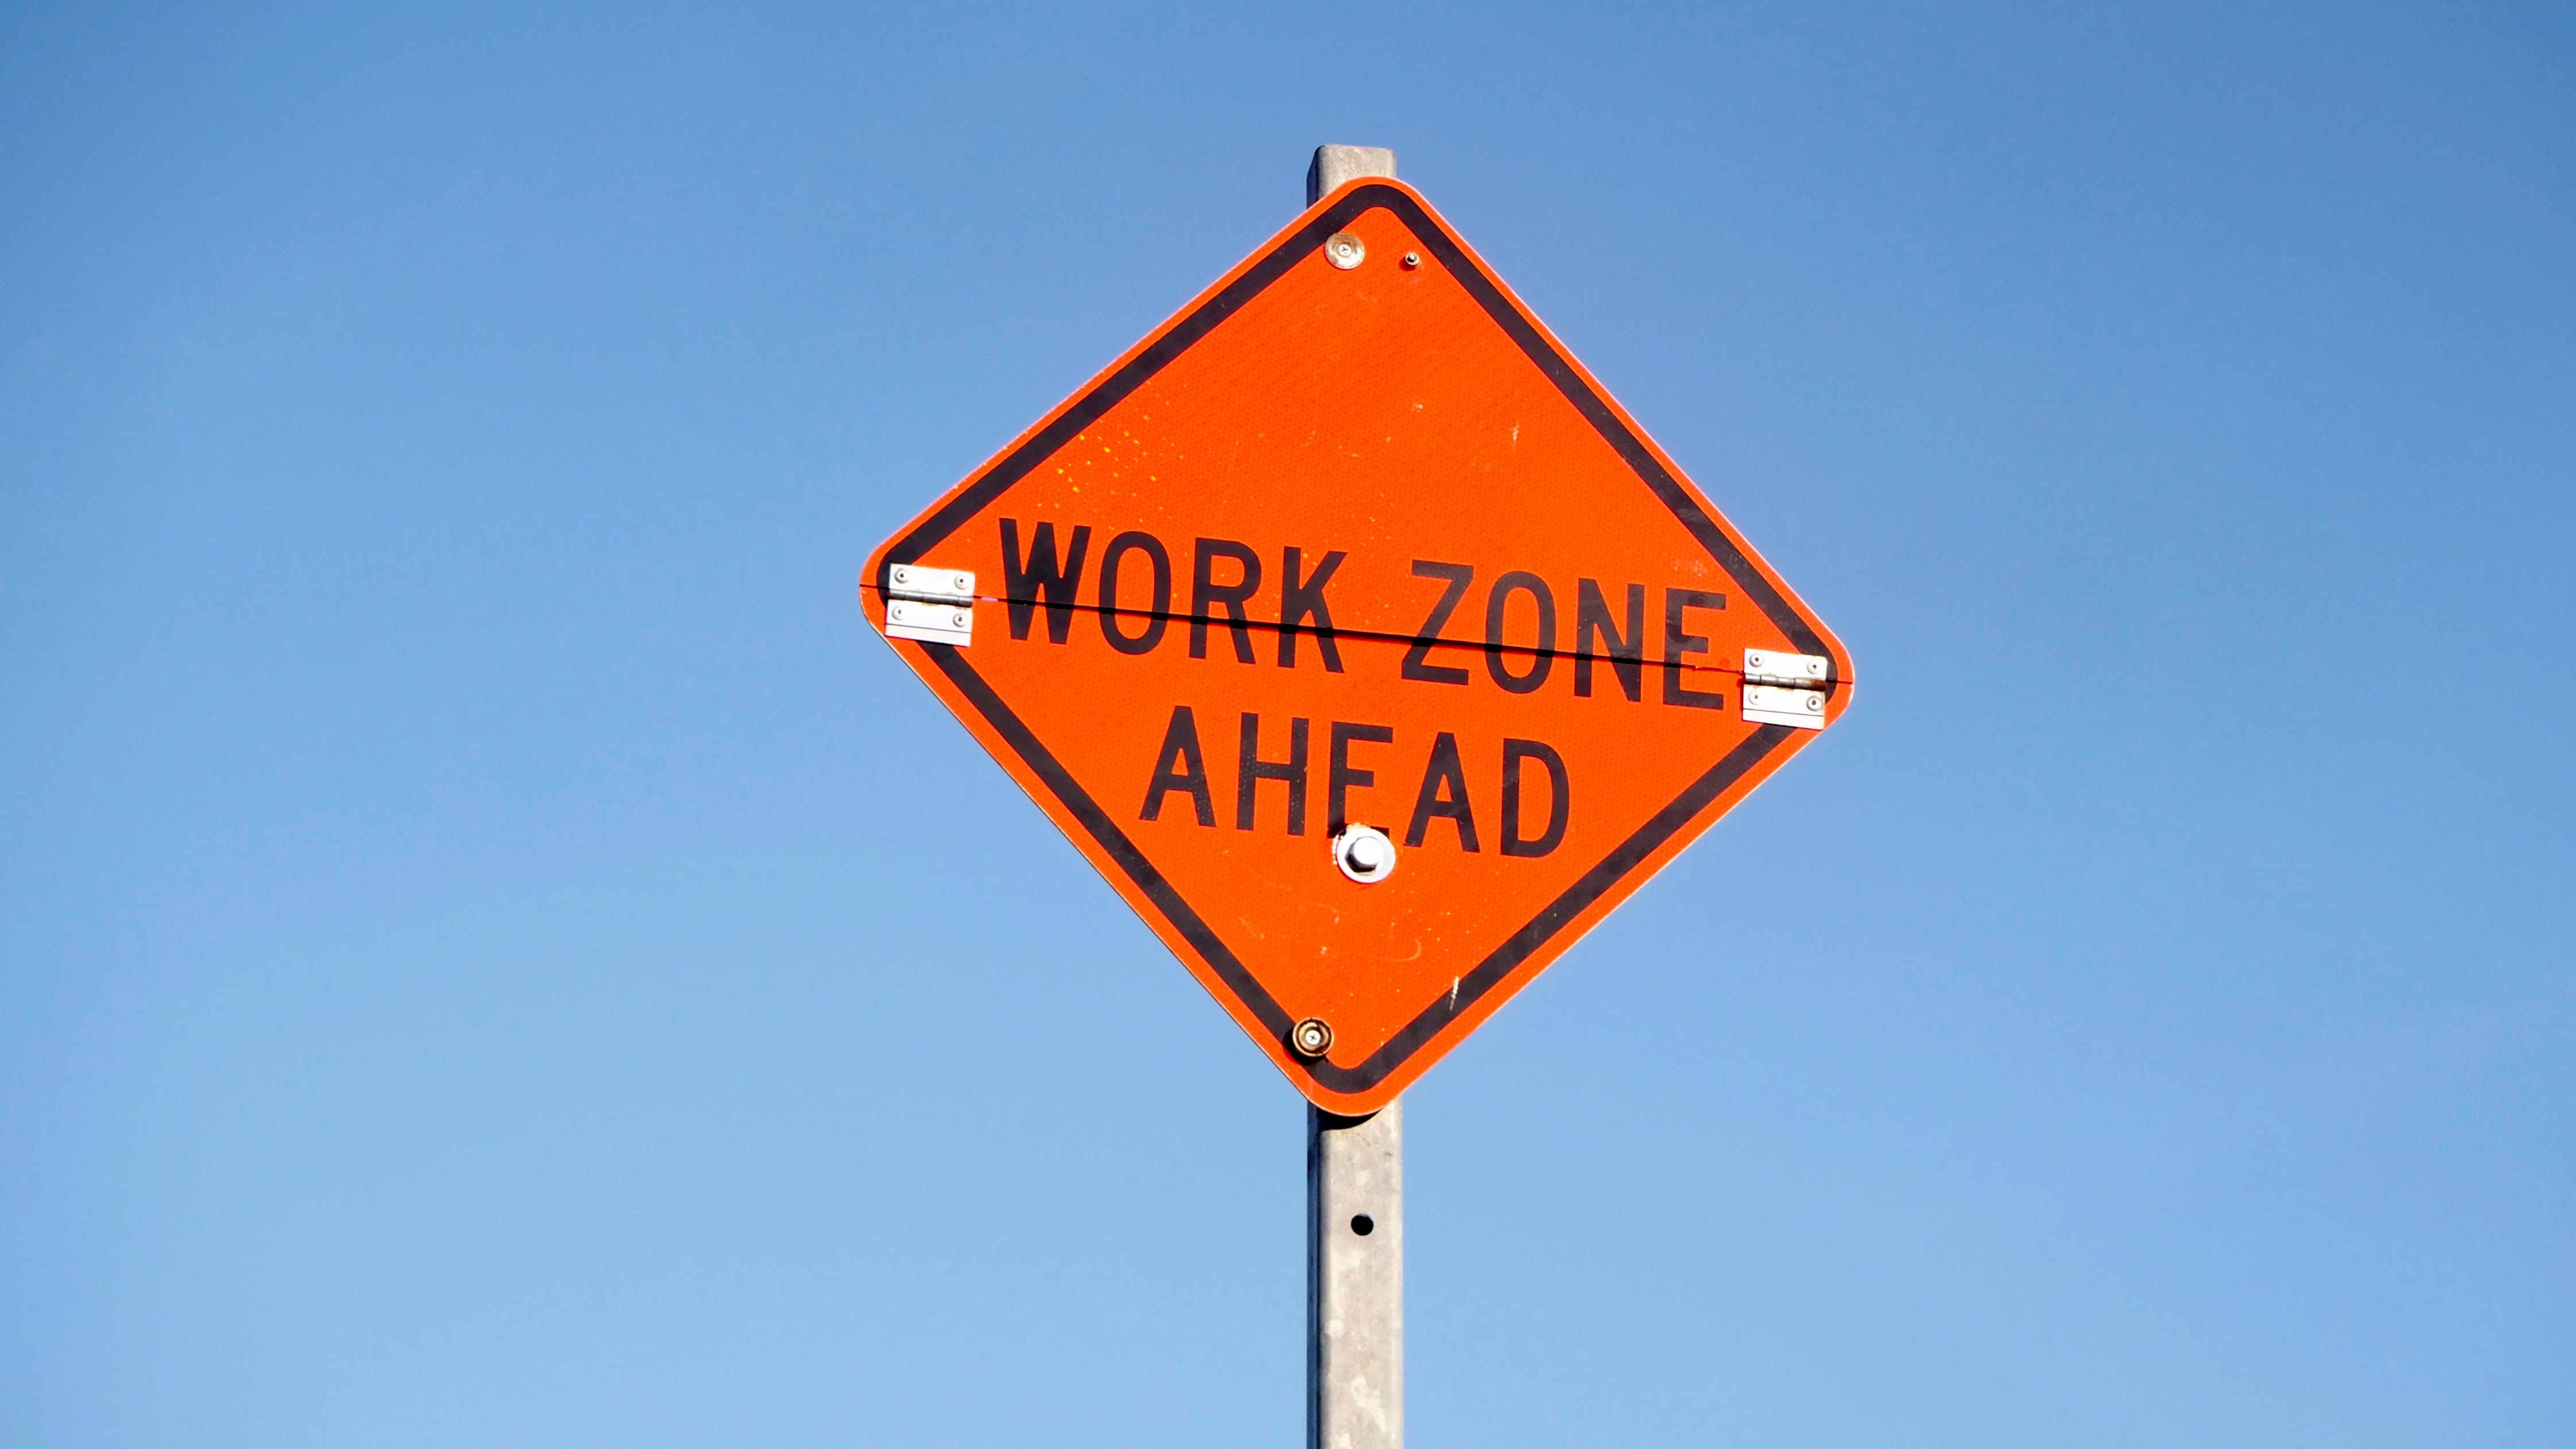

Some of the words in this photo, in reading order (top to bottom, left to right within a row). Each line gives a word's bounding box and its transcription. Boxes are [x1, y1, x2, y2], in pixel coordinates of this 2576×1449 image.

[999, 517, 1348, 674] WORK
[1401, 559, 1727, 710] ZONE
[1139, 705, 1570, 858] AHEAD
